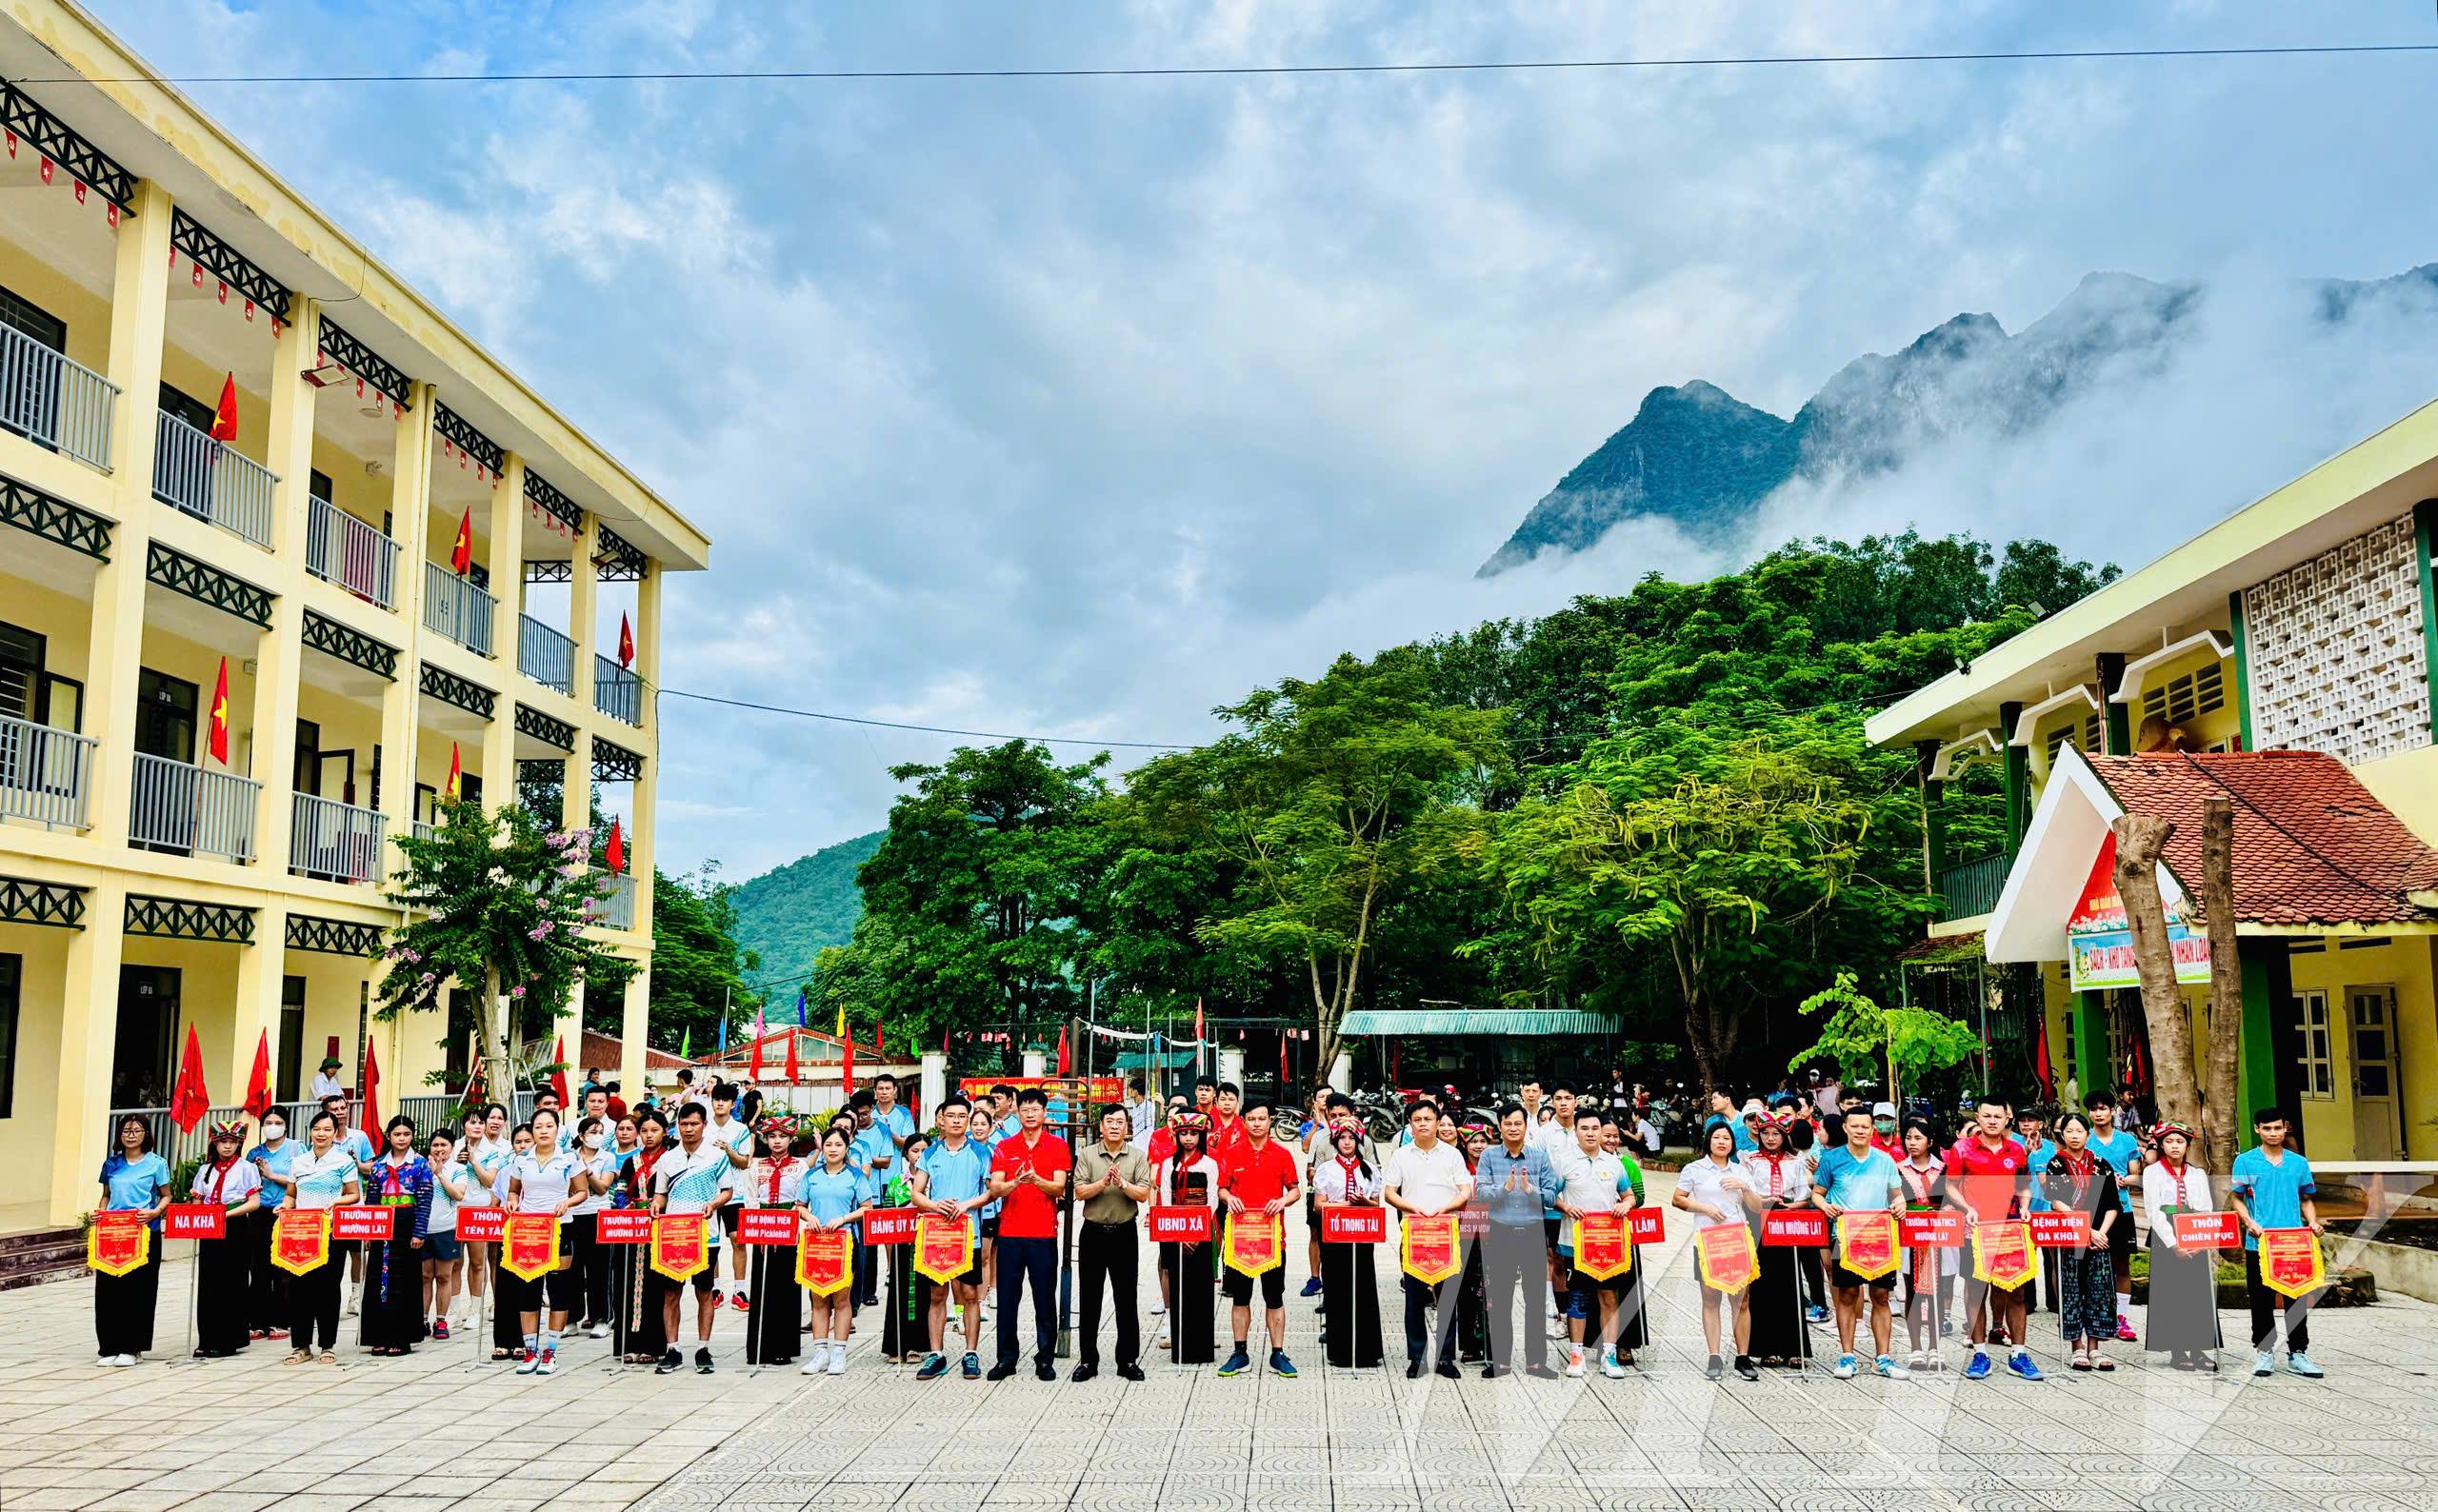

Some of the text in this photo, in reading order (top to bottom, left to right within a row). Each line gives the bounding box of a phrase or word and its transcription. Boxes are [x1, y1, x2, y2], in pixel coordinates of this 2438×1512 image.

[340, 1209, 371, 1220] TRƯỜNG
[472, 1210, 503, 1222] THÔN
[175, 1215, 190, 1228] NA
[870, 1216, 894, 1235] ĐẢNG
[896, 1214, 908, 1233] ỦY
[1158, 1214, 1204, 1231] UBND XÃ
[1341, 1218, 1366, 1235] TRỌNG
[1635, 1216, 1656, 1234] LÂM
[1767, 1219, 1785, 1235] THÔN
[2032, 1216, 2084, 1229] BỆNH VIỆN
[2191, 1217, 2223, 1228] THÔN
[339, 1224, 387, 1235] MƯỜNG LÁT
[2053, 1231, 2080, 1241] KHOA
